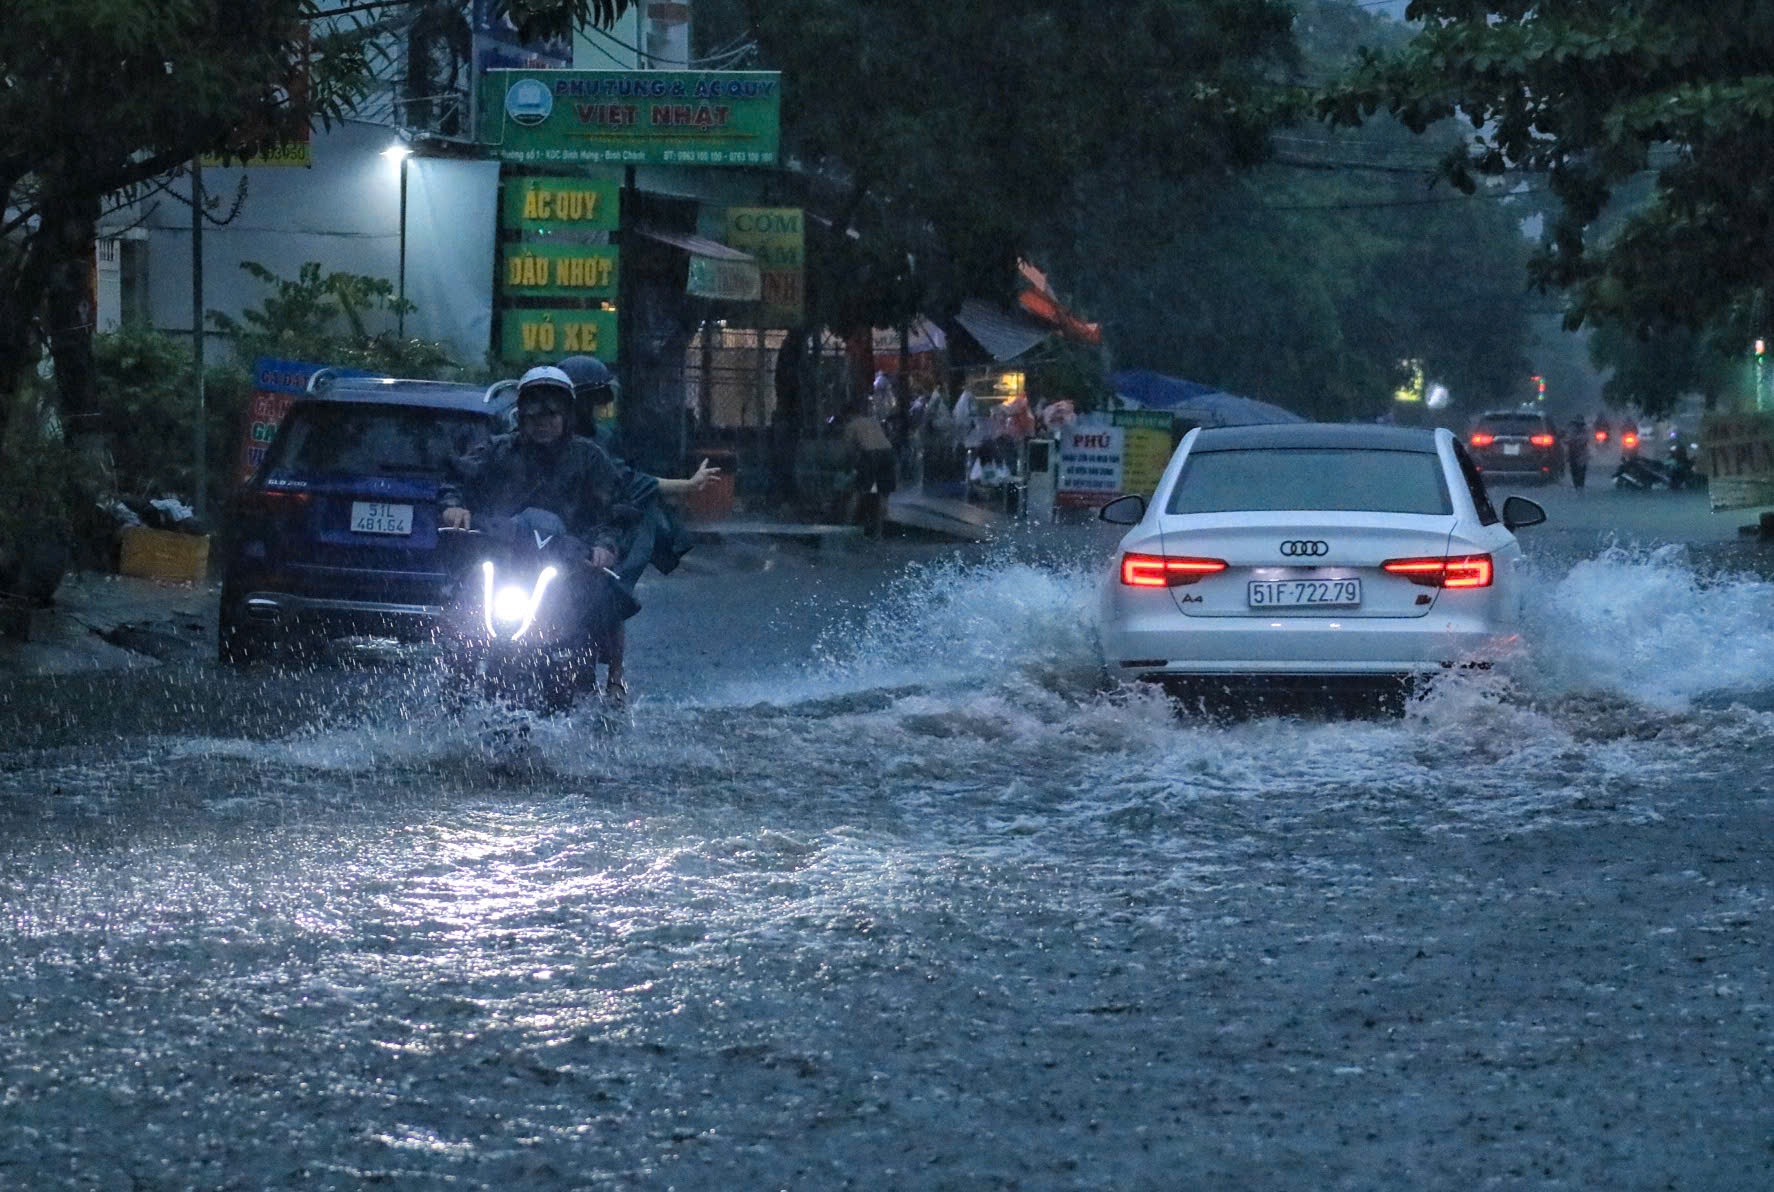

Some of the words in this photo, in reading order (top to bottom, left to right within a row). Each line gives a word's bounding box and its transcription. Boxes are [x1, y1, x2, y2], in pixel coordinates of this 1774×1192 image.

[670, 79, 687, 96] &
[727, 79, 776, 97] QUY
[575, 98, 640, 129] VIỆT
[651, 99, 730, 132] NHẬT
[556, 191, 597, 220] QUY
[509, 247, 549, 286] DẦU
[521, 313, 555, 352] VỎ
[563, 321, 600, 352] XE
[1072, 431, 1111, 448] PHÚ
[368, 504, 395, 518] 51L
[1182, 593, 1204, 604] A4
[1253, 582, 1356, 605] 51F-722.79
